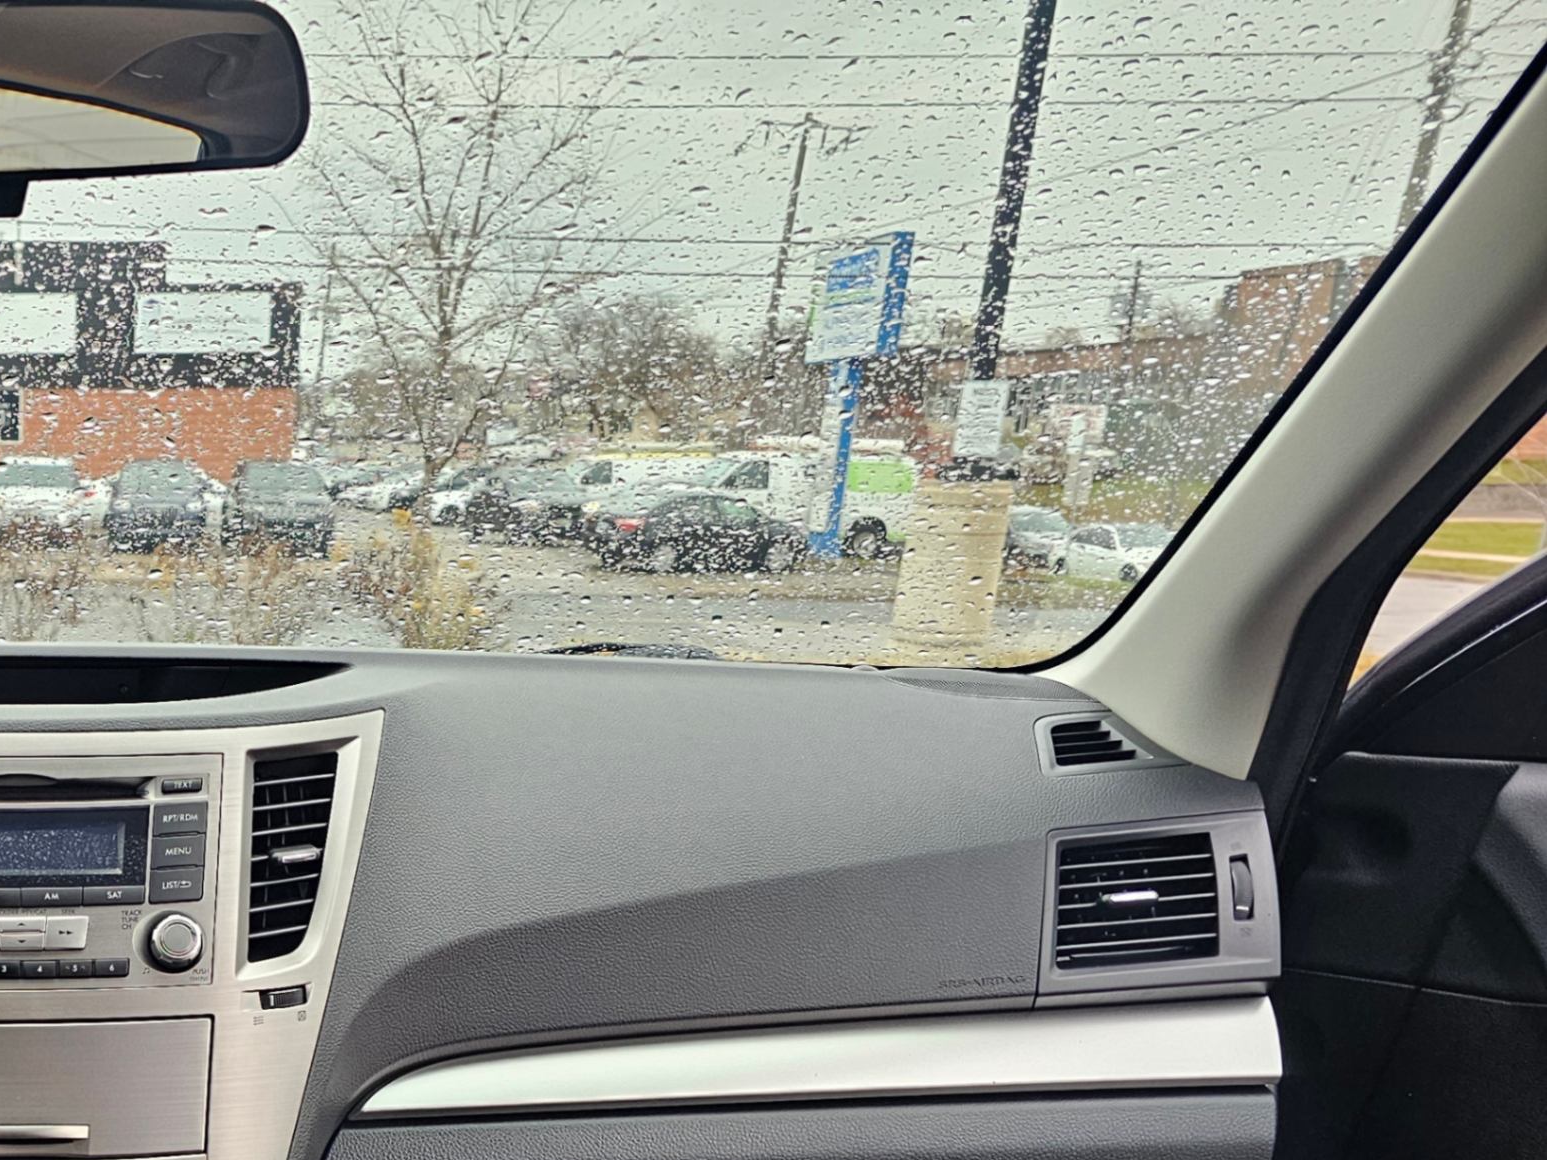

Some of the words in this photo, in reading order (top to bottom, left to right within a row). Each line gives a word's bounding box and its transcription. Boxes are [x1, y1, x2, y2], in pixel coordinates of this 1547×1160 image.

[173, 781, 193, 789] TEXT
[162, 813, 198, 823] RPT/RDM
[164, 847, 192, 855] MENU
[44, 892, 59, 900] AM
[106, 890, 123, 900] SAT
[1, 965, 7, 973] 3
[37, 965, 43, 973] 4
[72, 965, 78, 973] 5
[109, 964, 115, 972] 6
